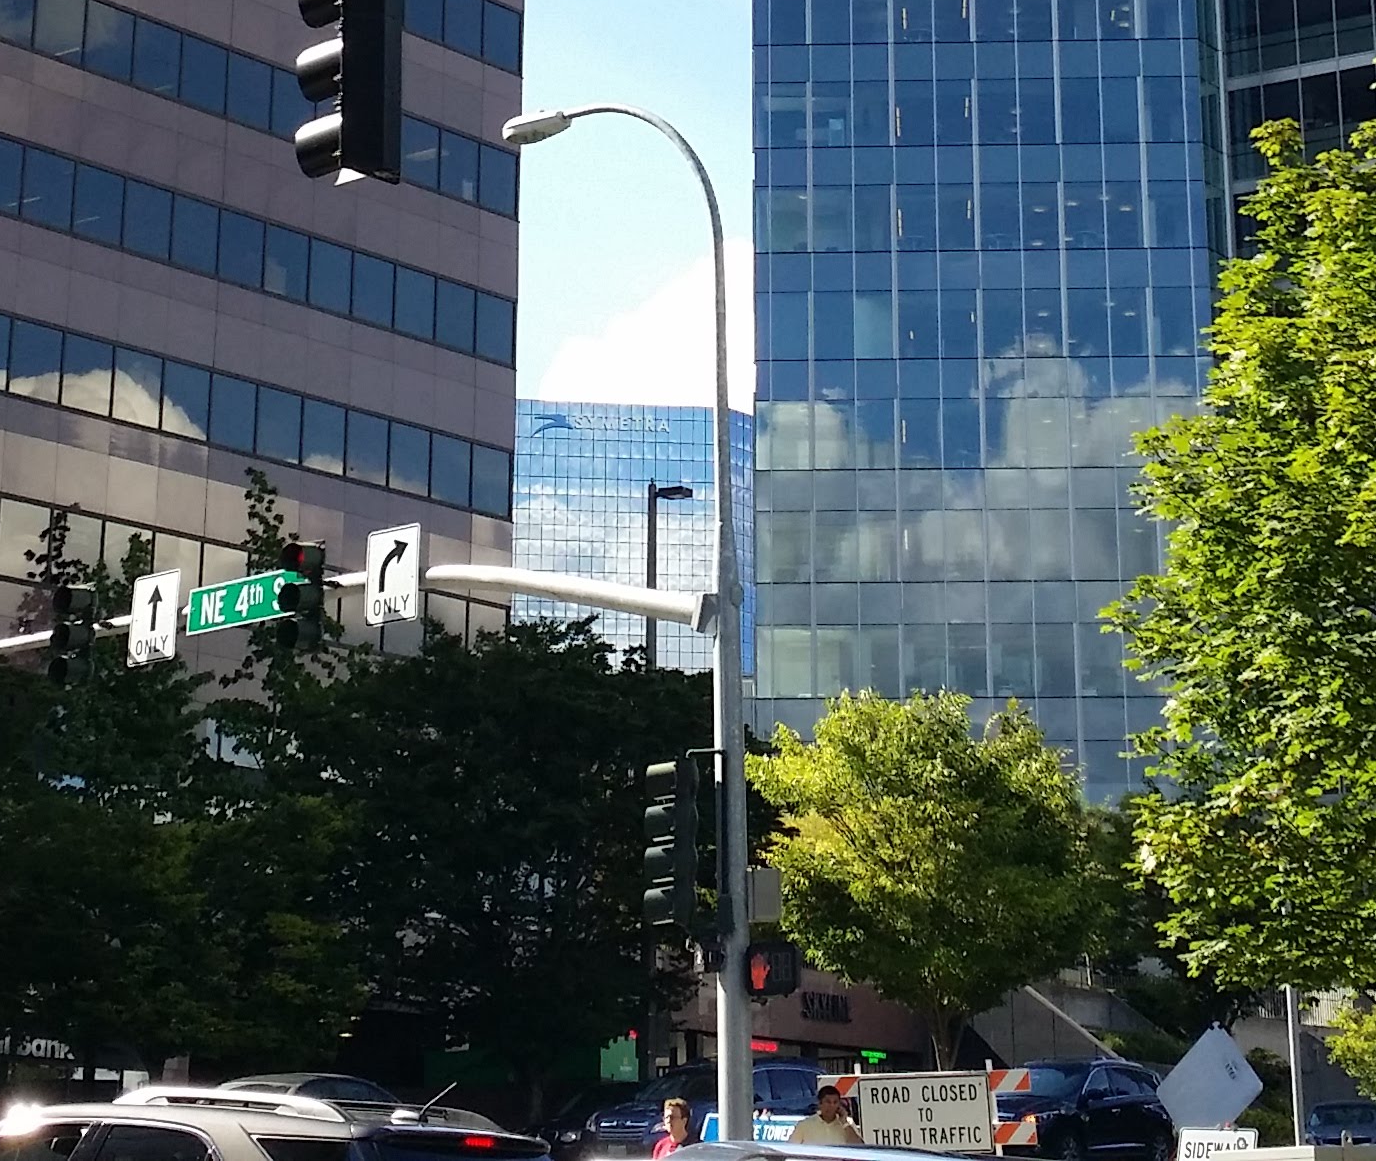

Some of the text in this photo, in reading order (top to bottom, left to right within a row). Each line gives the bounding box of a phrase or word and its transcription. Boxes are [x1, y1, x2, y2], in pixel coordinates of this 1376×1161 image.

[574, 414, 670, 434] SYMETRA
[200, 588, 228, 627] NE
[234, 581, 264, 618] 4th
[373, 593, 411, 617] ONLY
[135, 634, 169, 656] ONLY
[870, 1084, 977, 1104] ROAD CLOSED
[917, 1107, 933, 1122] TO
[873, 1126, 982, 1146] THRU TRAFFIC
[1184, 1140, 1248, 1159] SIDEW
